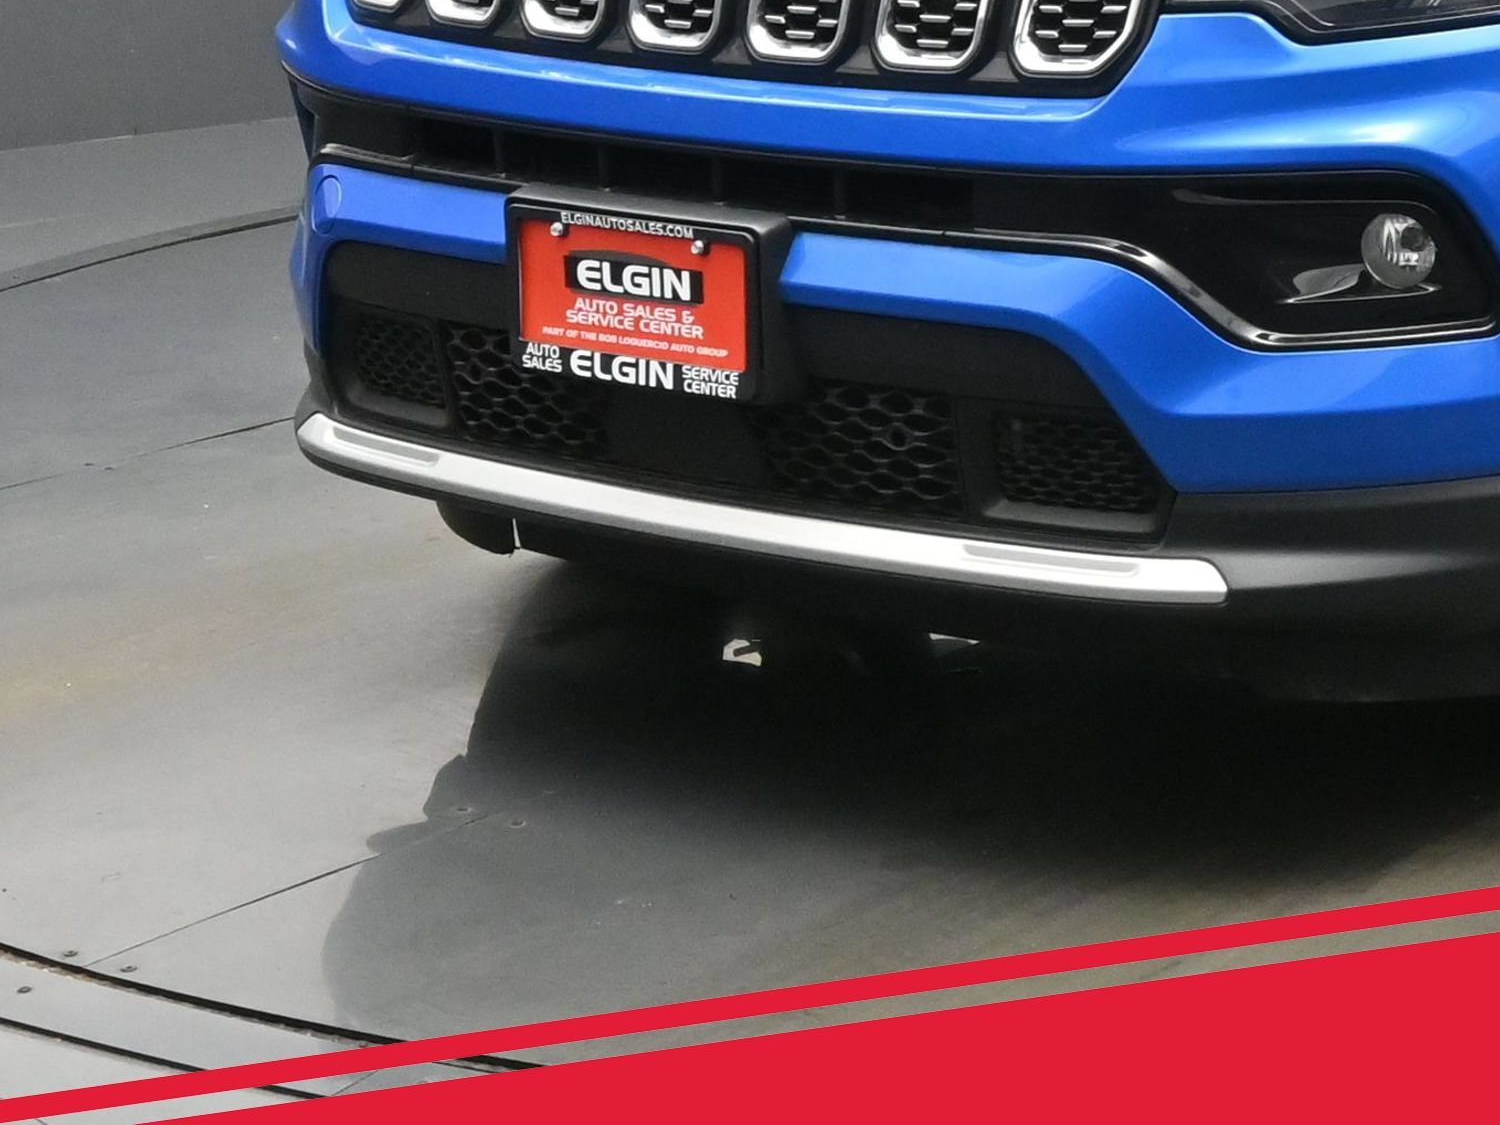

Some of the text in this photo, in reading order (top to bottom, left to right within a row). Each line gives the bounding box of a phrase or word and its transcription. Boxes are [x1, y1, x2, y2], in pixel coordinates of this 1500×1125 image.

[576, 258, 692, 302] ELGIN
[574, 297, 695, 324] AUTO SALES &
[565, 309, 704, 340] SERVICE CENTER
[525, 342, 560, 359] AUTO
[522, 355, 562, 373] SALES
[569, 349, 674, 390] ELGIN
[682, 365, 739, 385] SERVICE
[683, 379, 737, 399] CENTER
